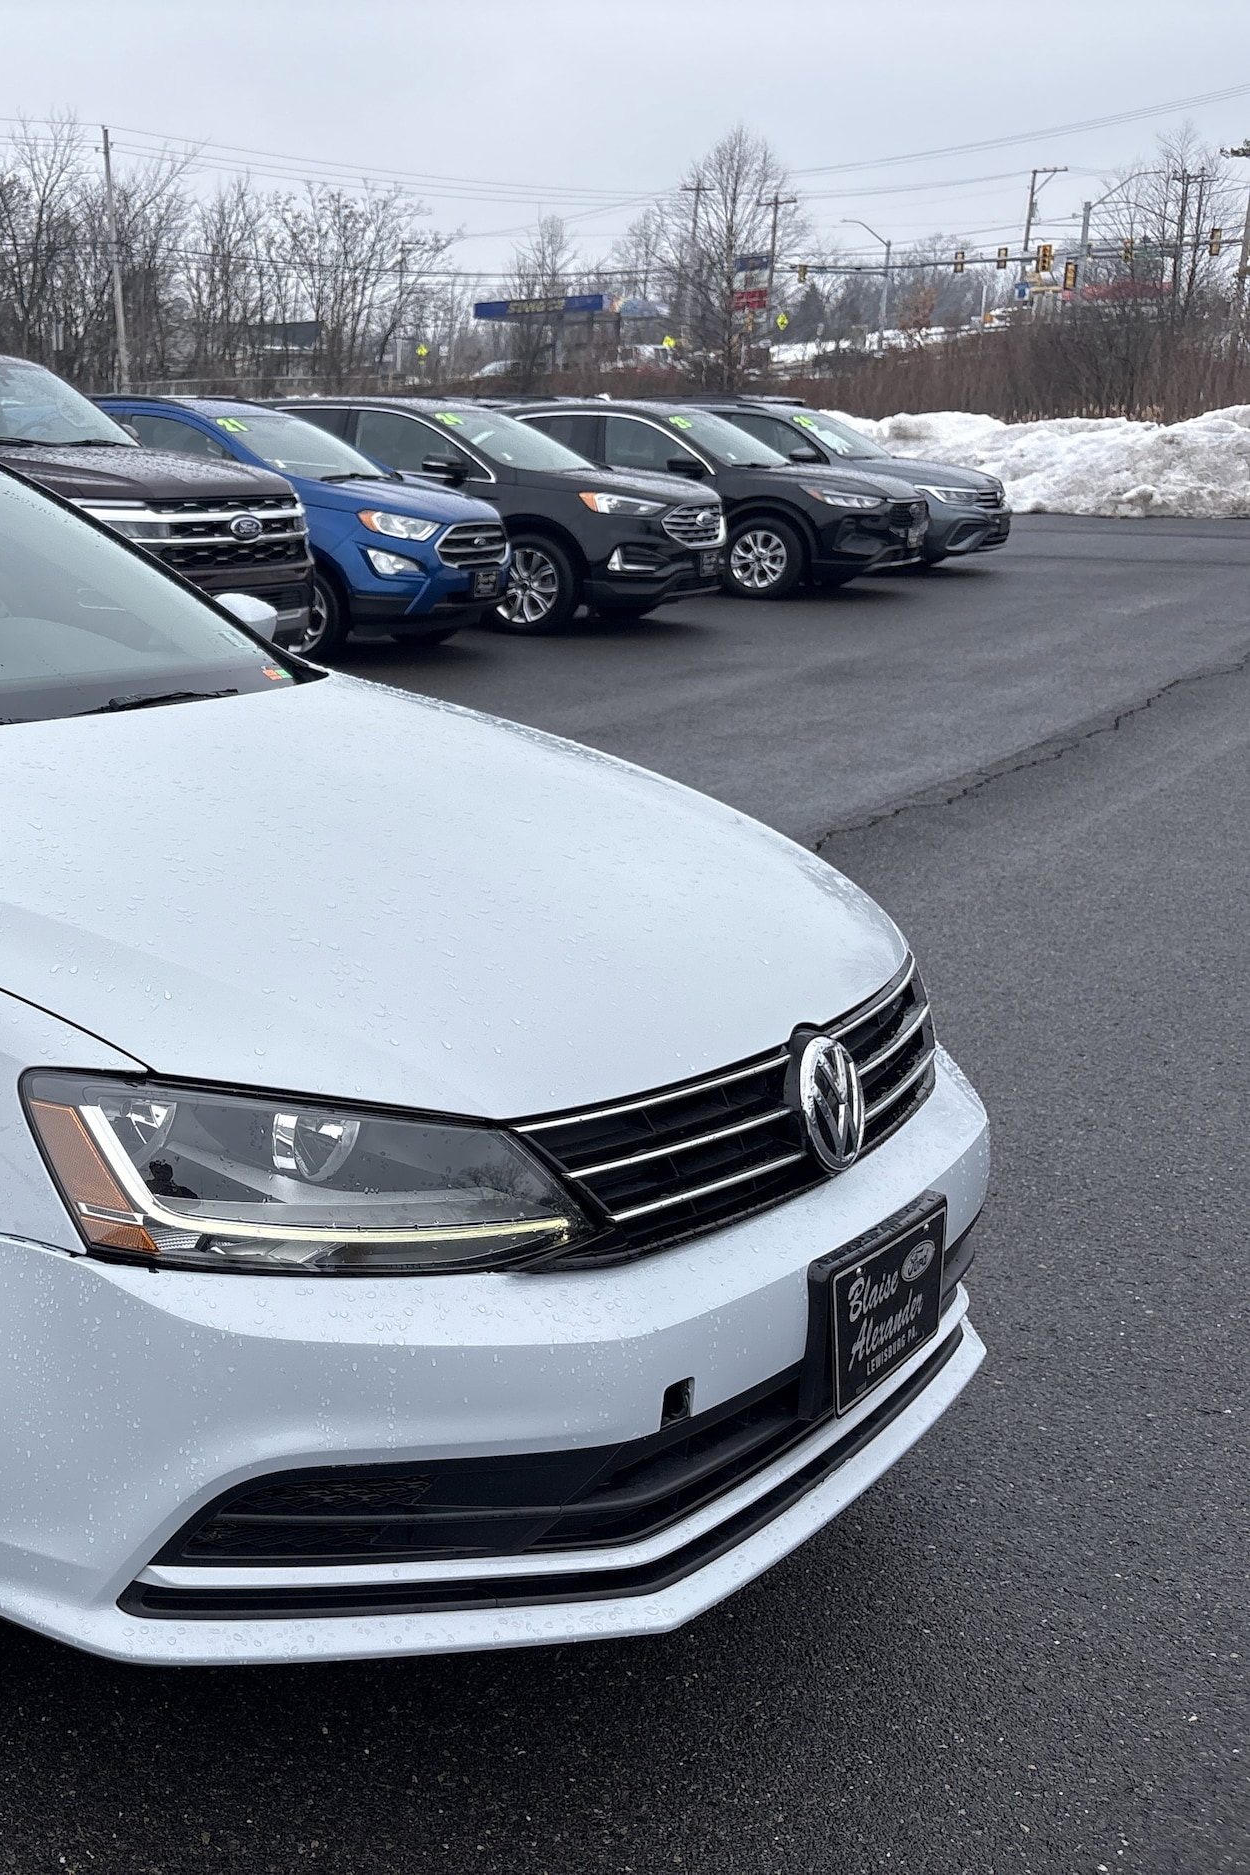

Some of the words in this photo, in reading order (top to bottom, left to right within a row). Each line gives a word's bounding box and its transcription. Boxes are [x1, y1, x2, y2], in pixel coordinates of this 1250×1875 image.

[216, 418, 250, 432] 21
[848, 1269, 900, 1323] Blaise
[848, 1288, 924, 1372] Alexander
[866, 1333, 907, 1376] LEWISBURG
